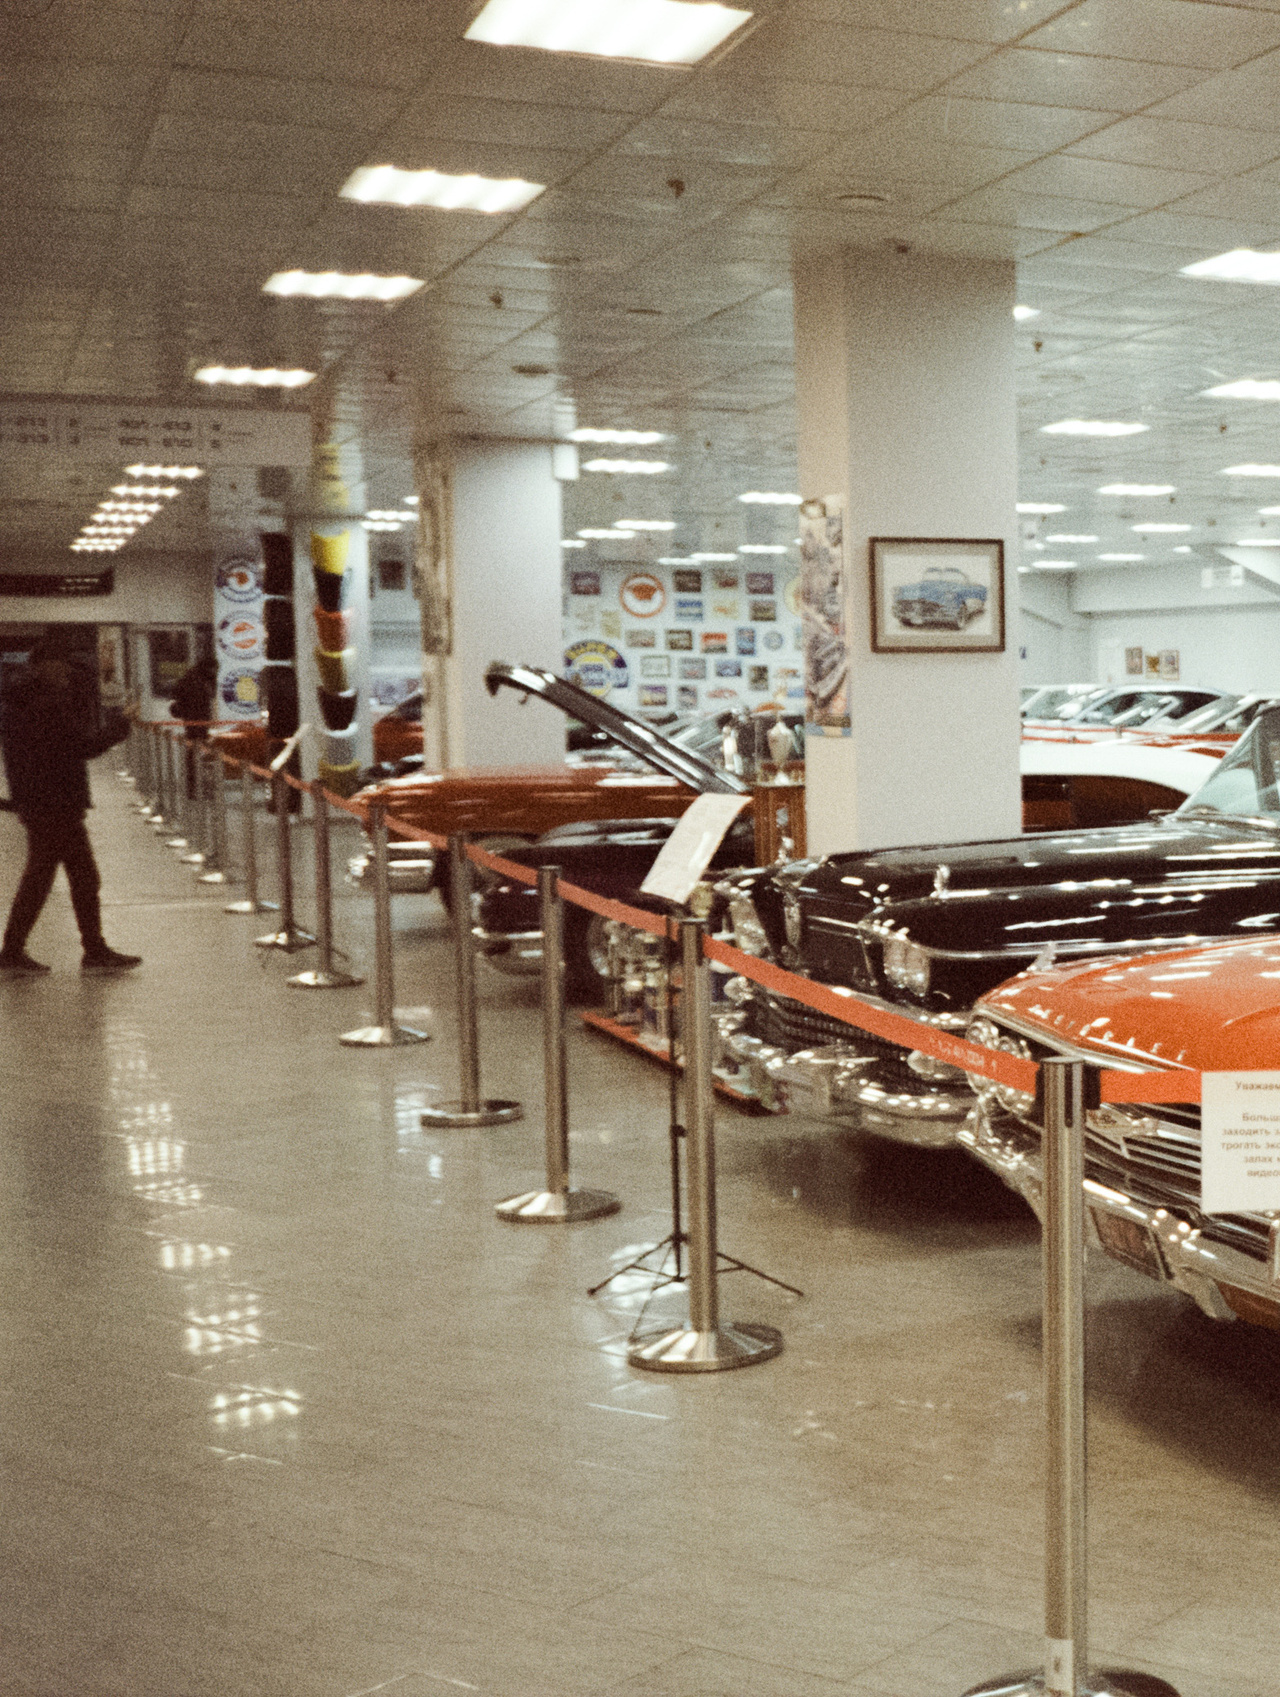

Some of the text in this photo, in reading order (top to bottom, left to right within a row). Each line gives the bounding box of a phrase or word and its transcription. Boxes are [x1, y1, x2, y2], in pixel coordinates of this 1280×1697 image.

[1222, 1128, 1271, 1136] заходить
[1221, 1141, 1261, 1150] трогать
[1244, 1155, 1273, 1163] залах
